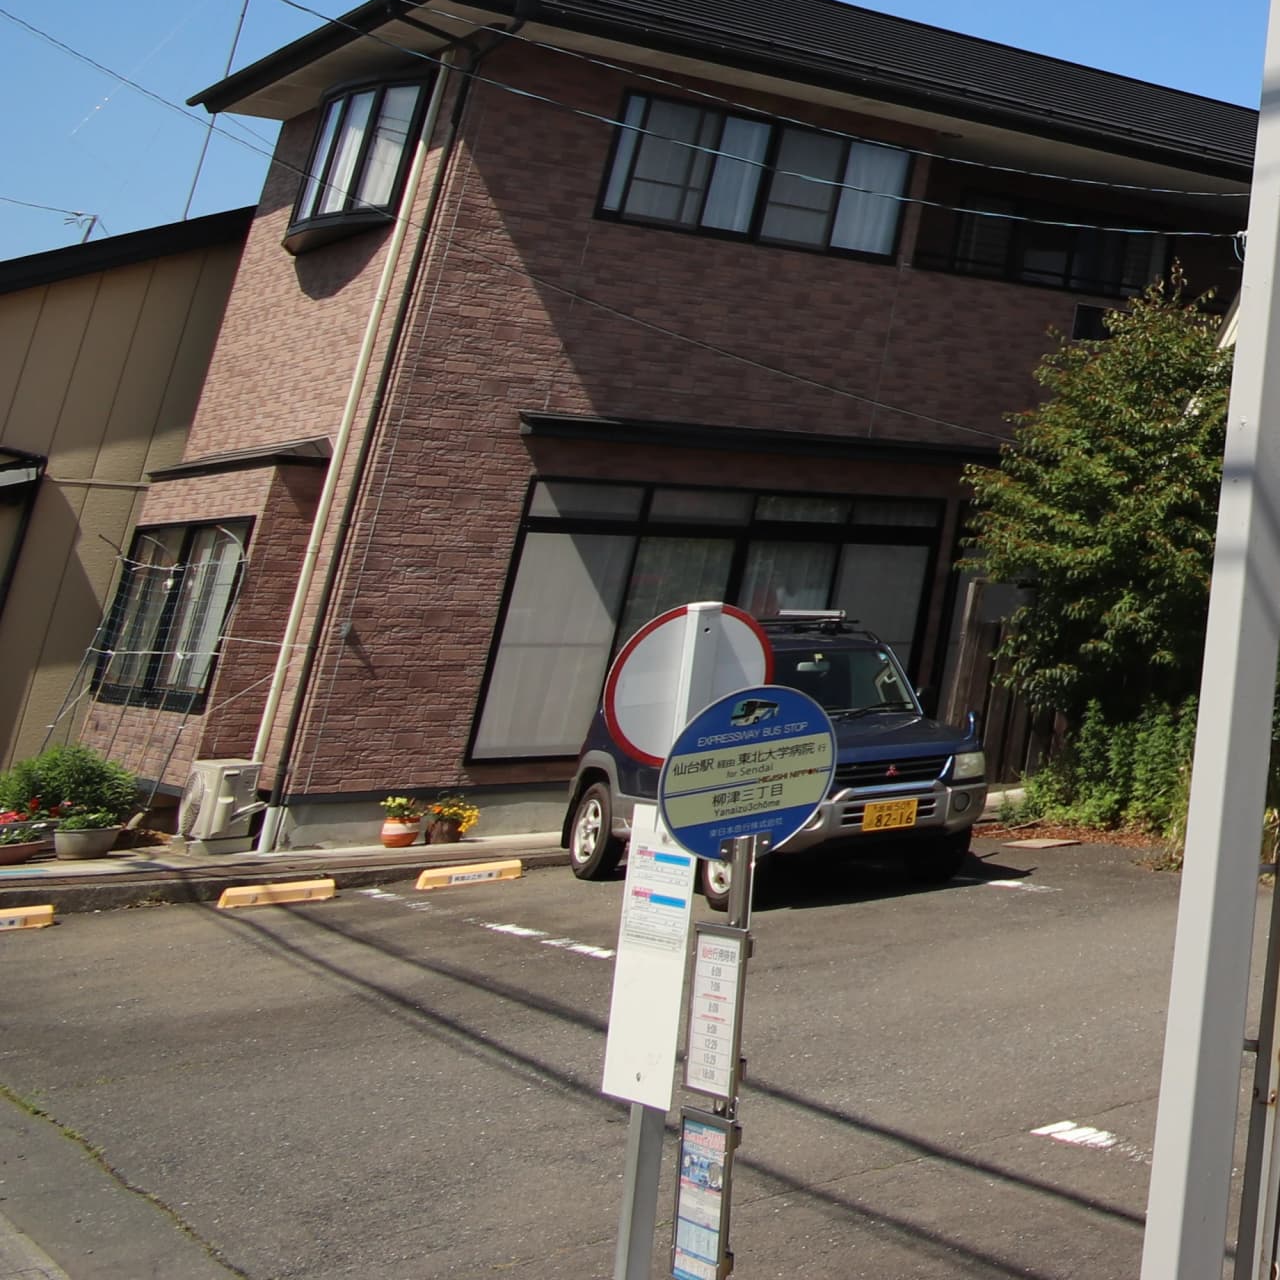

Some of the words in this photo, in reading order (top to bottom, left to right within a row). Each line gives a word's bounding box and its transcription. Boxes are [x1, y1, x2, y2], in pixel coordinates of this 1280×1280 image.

[697, 728, 760, 748] EXPRESSWAY
[763, 725, 782, 737] BUS
[784, 721, 808, 734] STOP
[673, 757, 714, 776] 仙台駅
[738, 742, 816, 764] 東北大学病院
[726, 770, 737, 778] for
[740, 763, 774, 777] Sendai
[712, 783, 783, 807] 柳津三丁目
